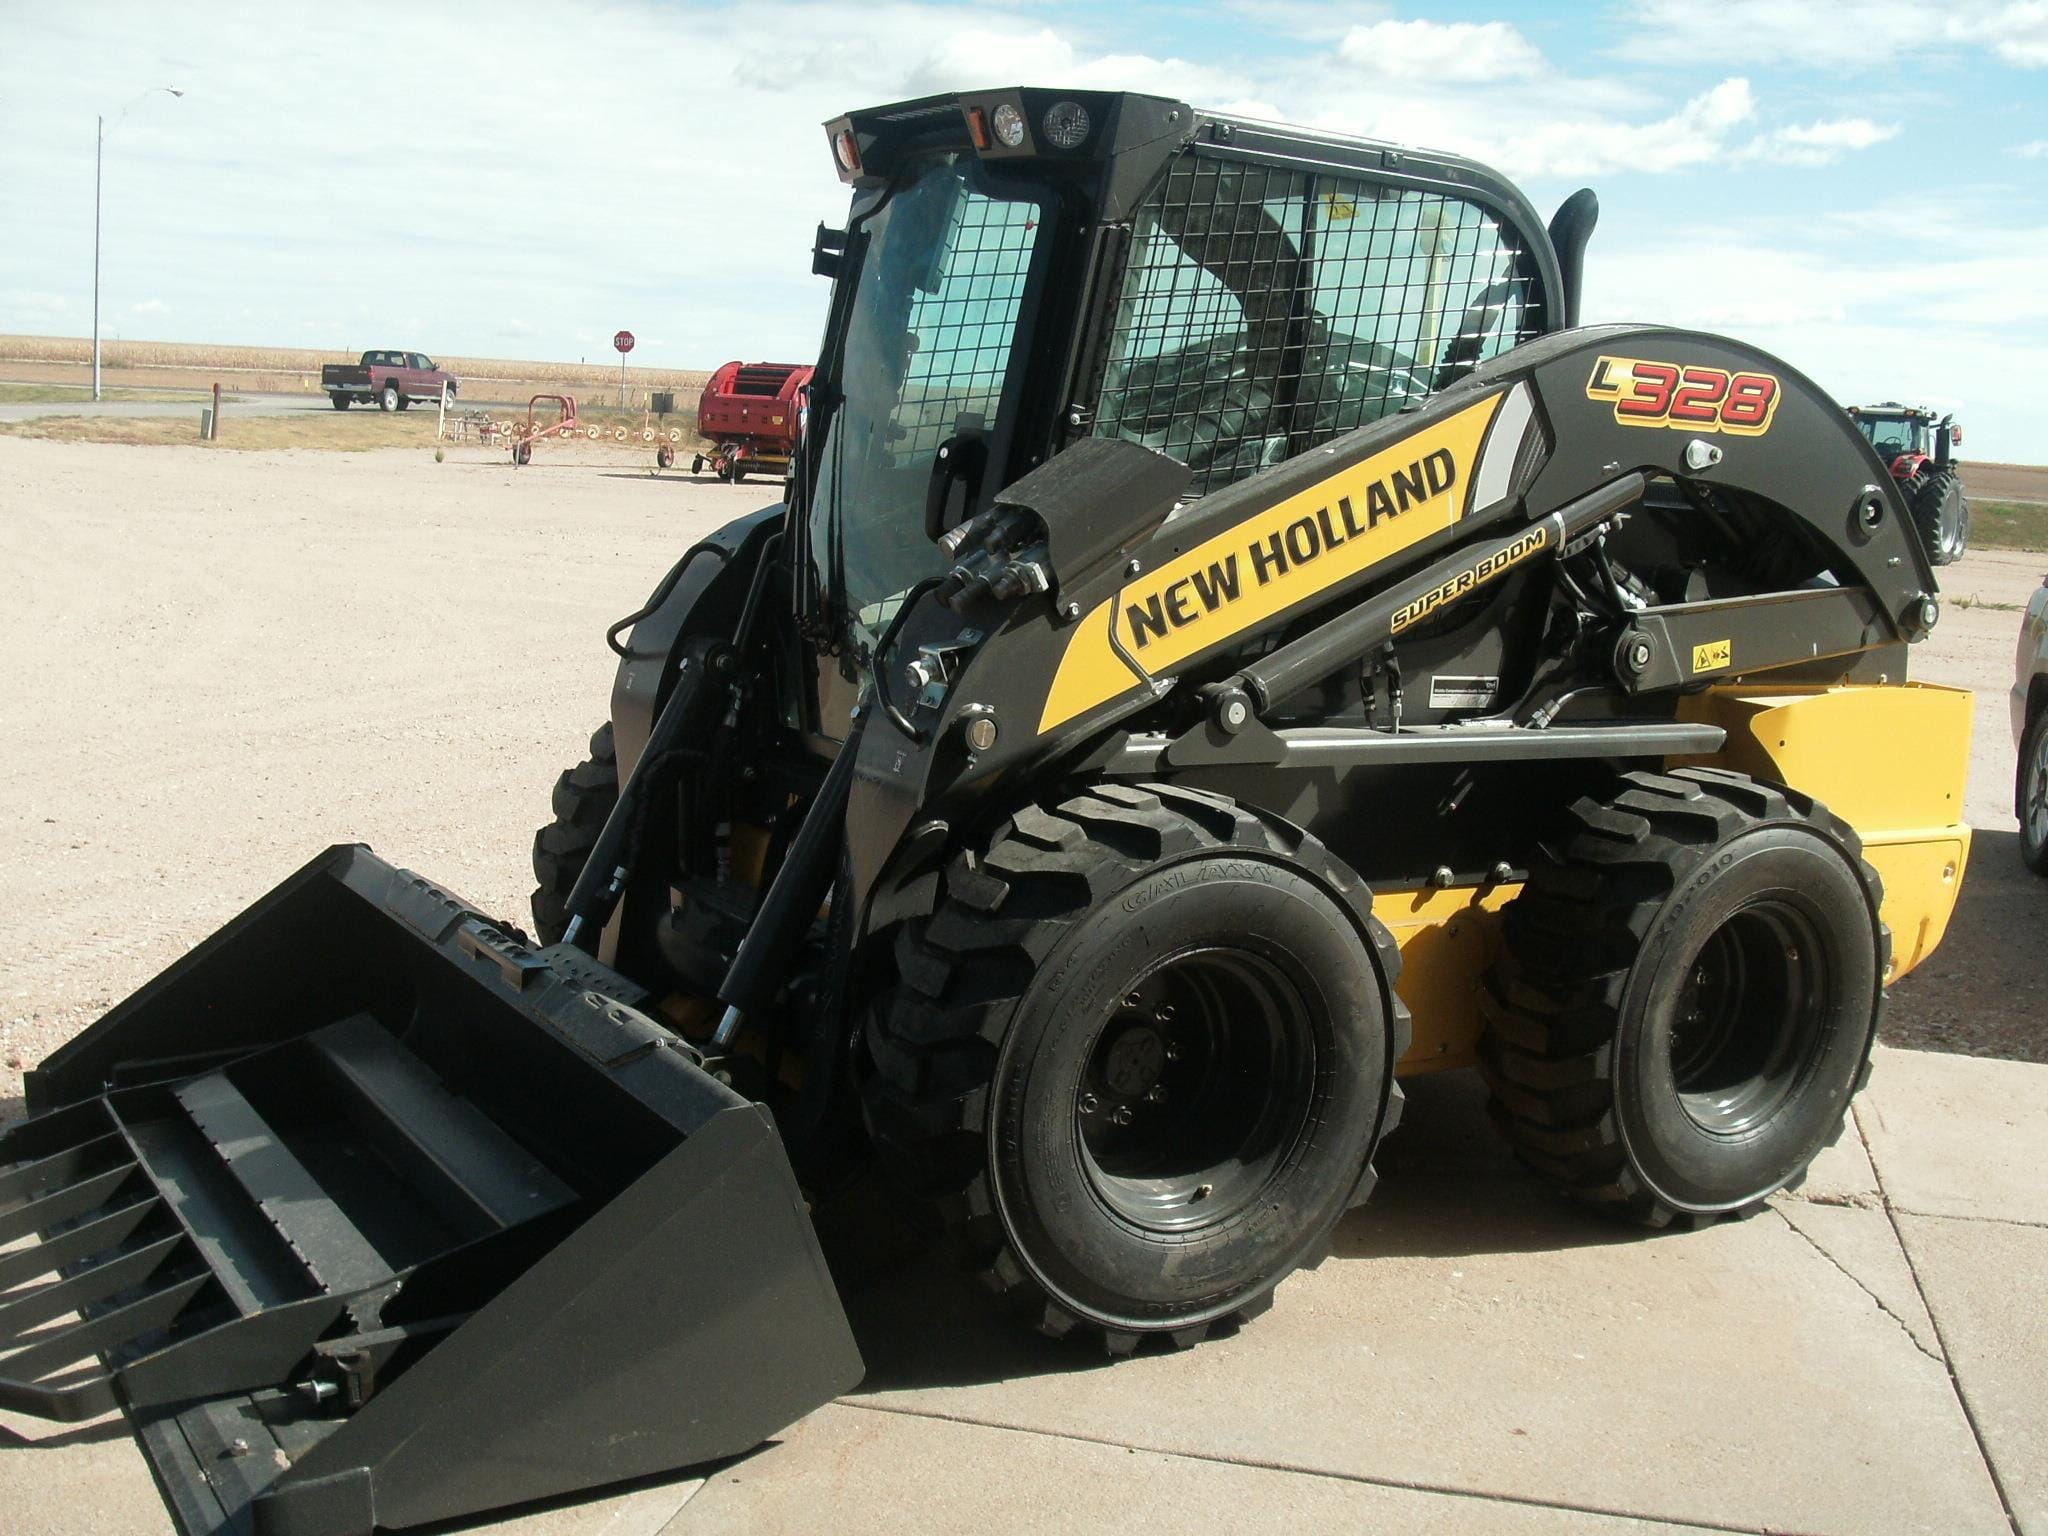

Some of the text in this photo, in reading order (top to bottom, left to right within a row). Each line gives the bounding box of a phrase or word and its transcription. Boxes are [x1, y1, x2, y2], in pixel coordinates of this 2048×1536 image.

[615, 337, 634, 347] STOP
[1588, 358, 1779, 433] L328
[1125, 446, 1457, 651] NEW HOLLAND
[1391, 527, 1546, 633] SUPER BOOM
